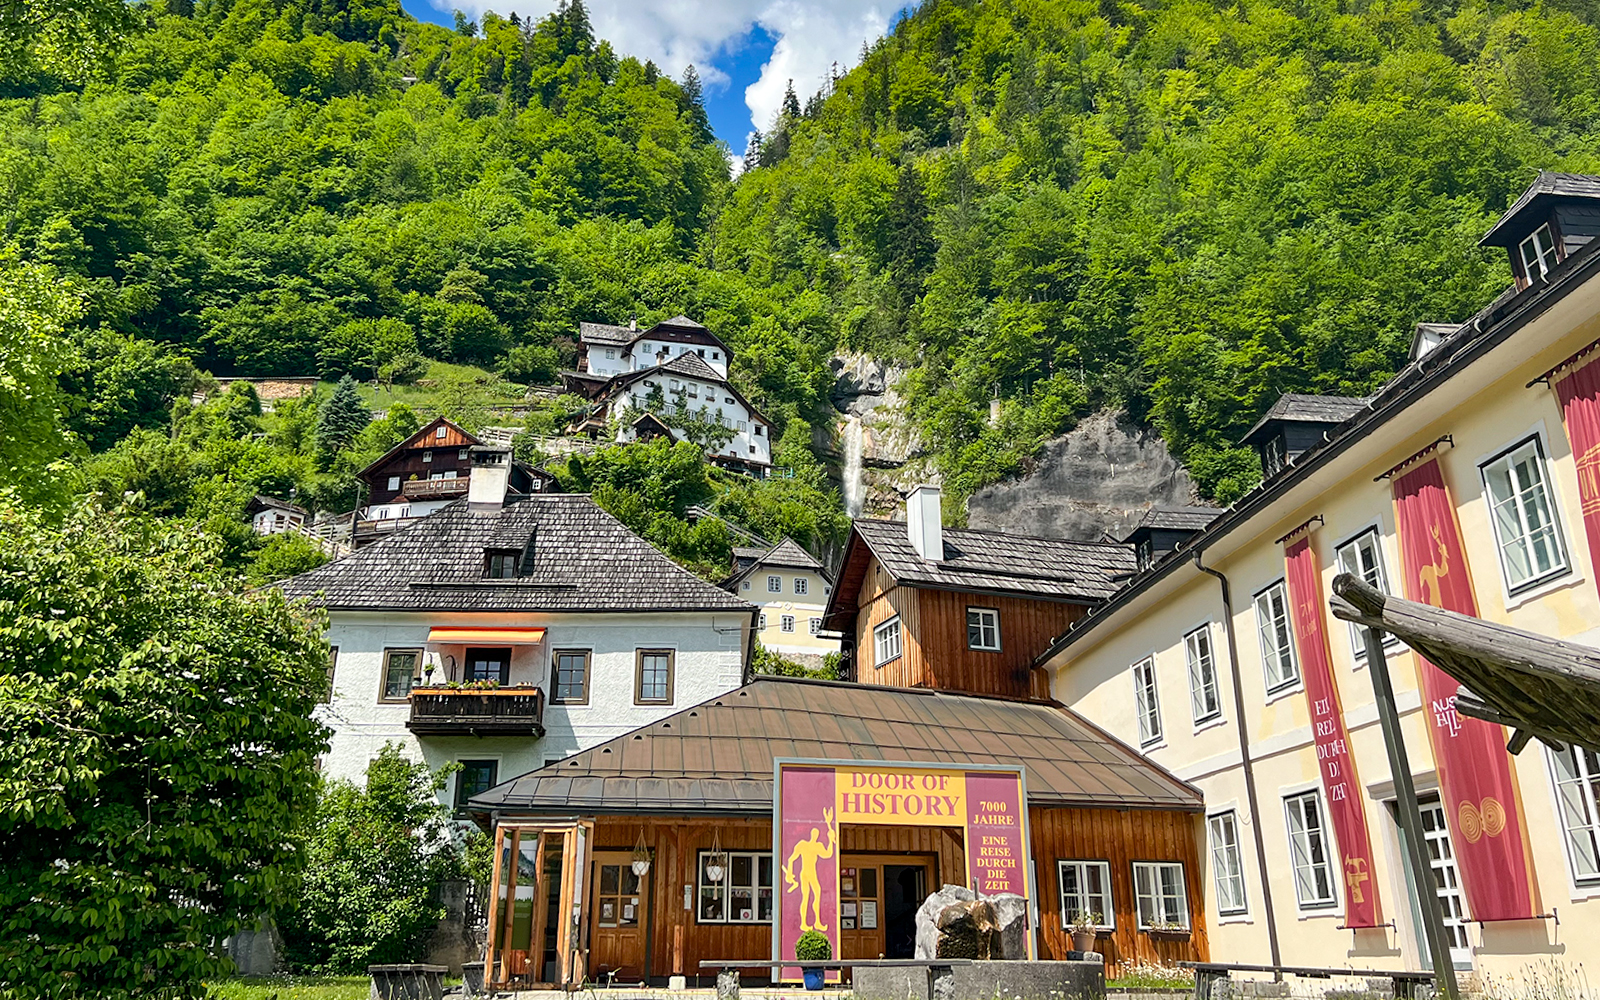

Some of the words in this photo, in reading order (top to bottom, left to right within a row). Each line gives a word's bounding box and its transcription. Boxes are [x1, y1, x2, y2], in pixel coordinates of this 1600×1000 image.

[851, 771, 916, 790] DOOR
[922, 774, 950, 791] OF
[841, 792, 960, 816] HISTORY
[979, 801, 1007, 812] 7000
[973, 814, 1015, 825] JAHRE
[982, 836, 1008, 846] EINE
[980, 847, 1011, 857] REISE
[976, 858, 1016, 868] DURCH
[987, 869, 1007, 879] DIE
[985, 880, 1010, 890] ZEIT
